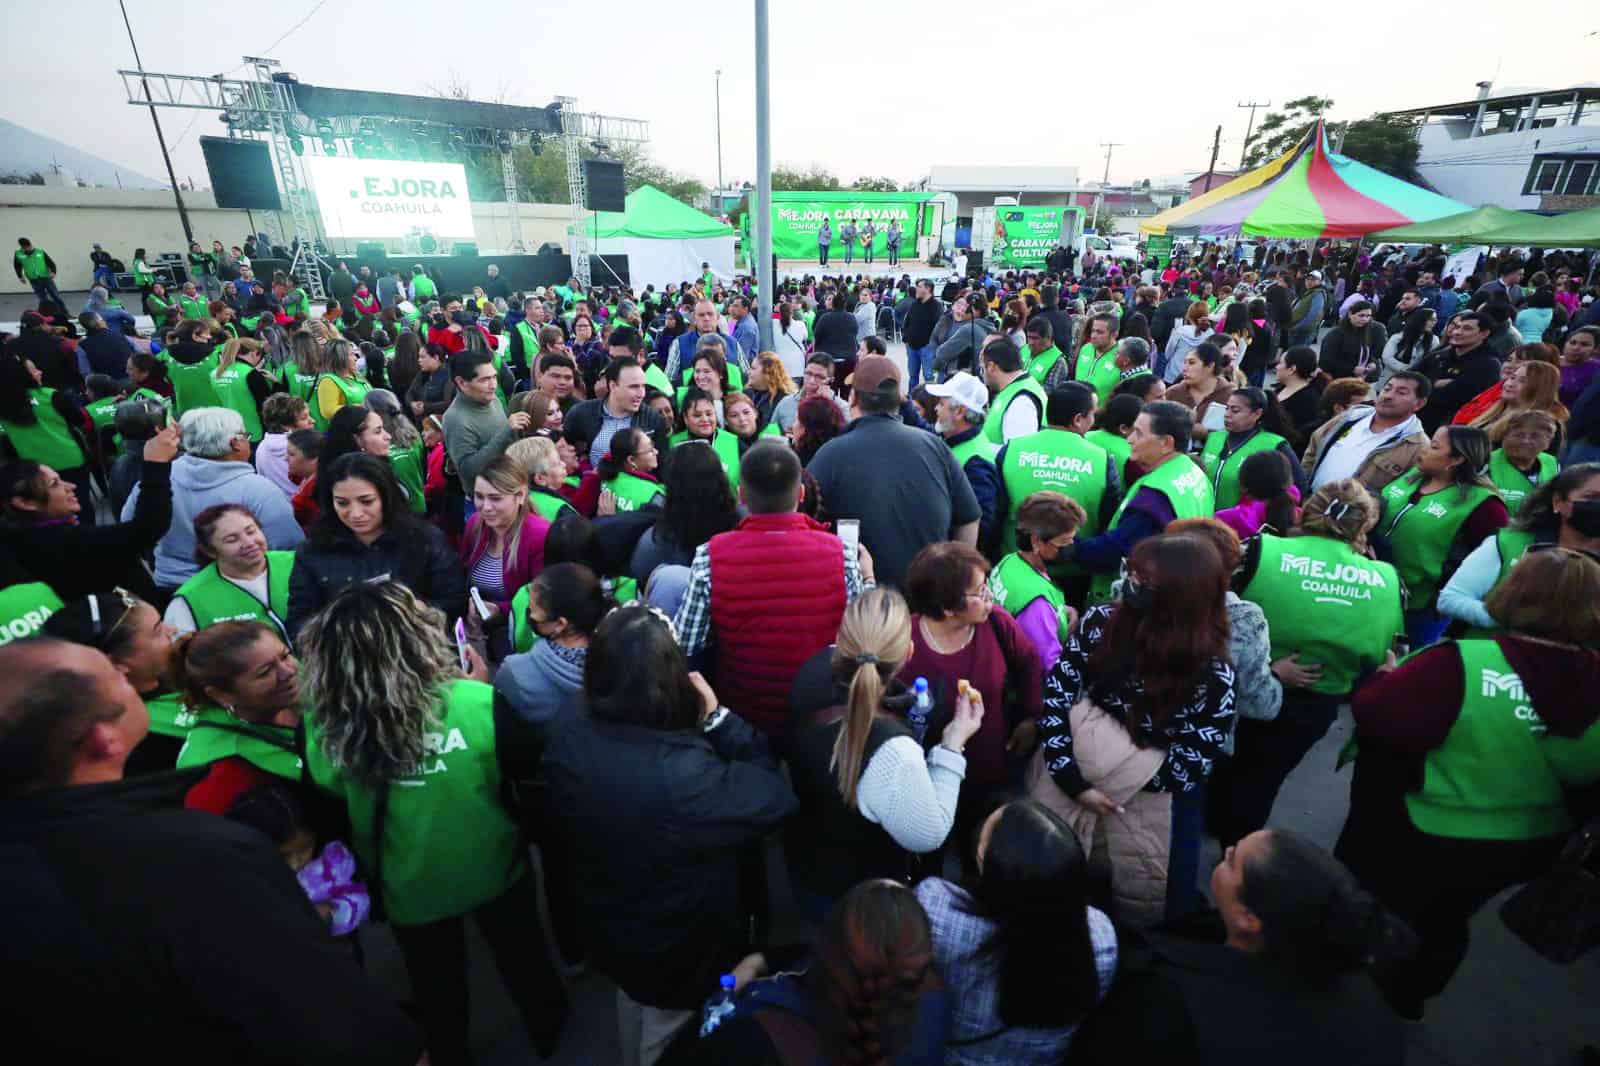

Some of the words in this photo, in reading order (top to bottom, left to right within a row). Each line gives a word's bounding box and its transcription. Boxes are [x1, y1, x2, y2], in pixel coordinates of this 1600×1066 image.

[349, 176, 456, 199] EJORA
[361, 200, 442, 216] COAHUILA
[778, 207, 830, 222] MEJORA
[834, 209, 909, 220] CARAVANA
[1018, 451, 1094, 475] MEJORA
[1032, 468, 1080, 483] COAHUILA
[1279, 552, 1387, 589] MEJORA
[1301, 578, 1373, 601] COAHUILA
